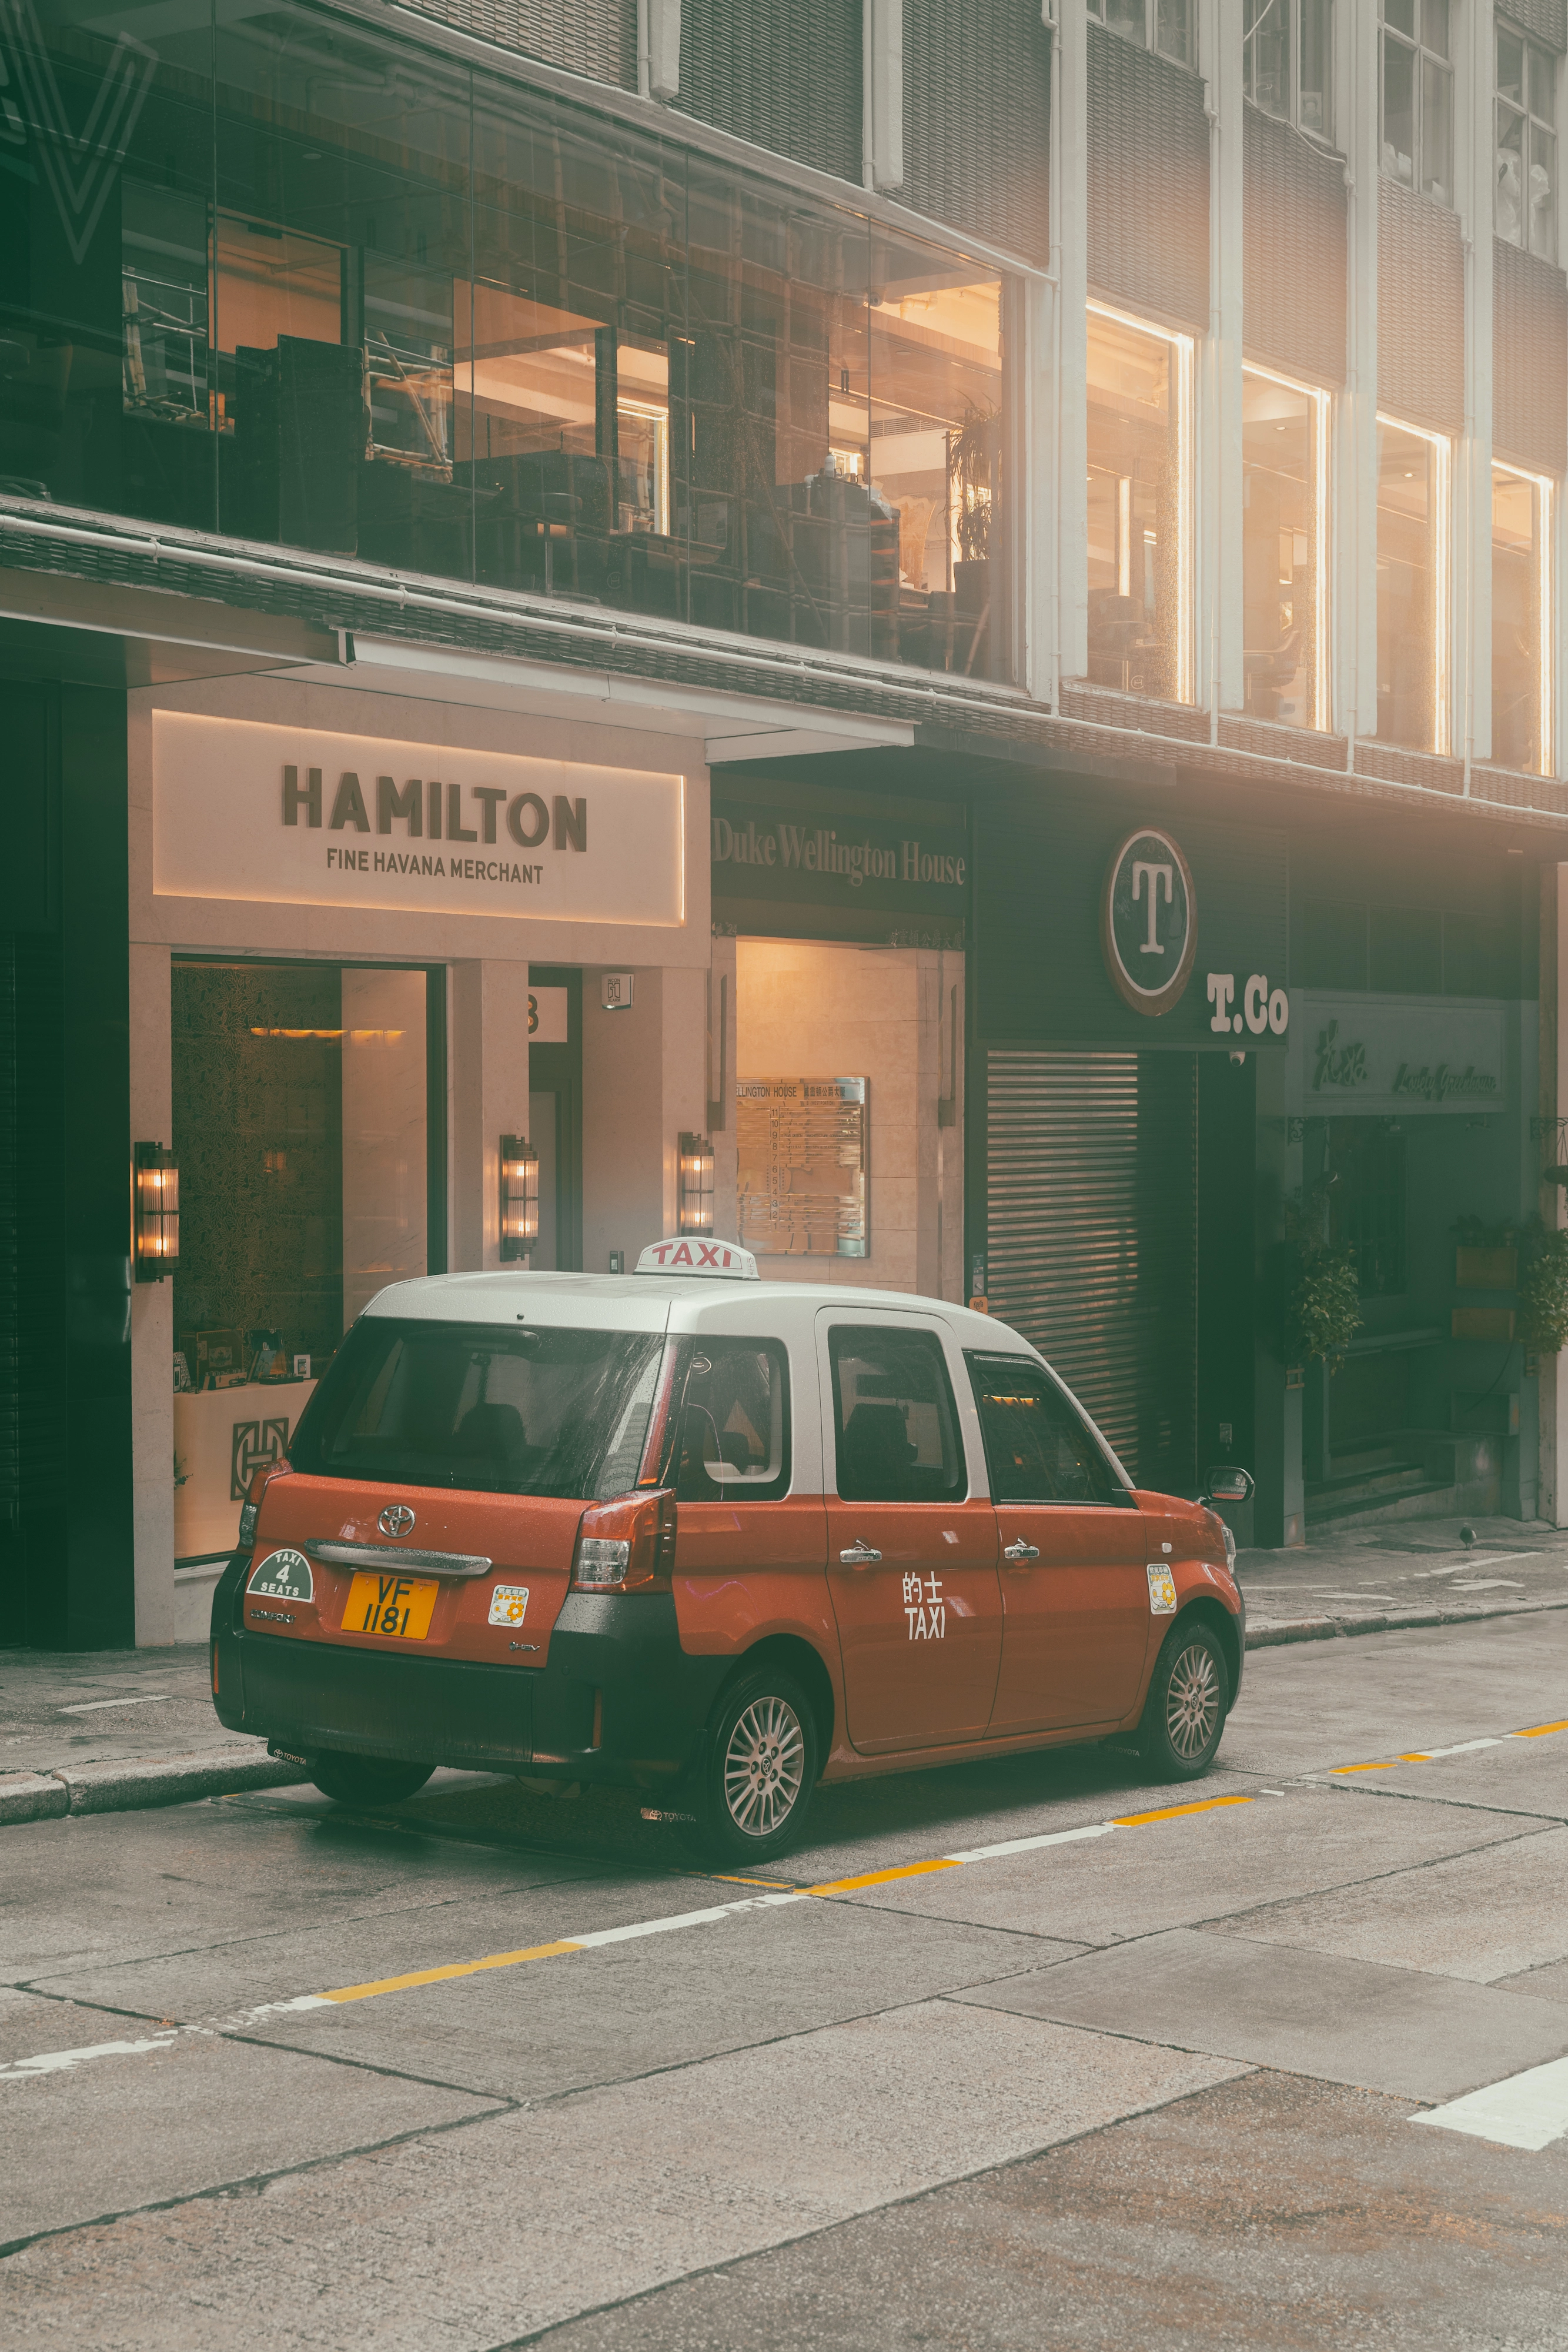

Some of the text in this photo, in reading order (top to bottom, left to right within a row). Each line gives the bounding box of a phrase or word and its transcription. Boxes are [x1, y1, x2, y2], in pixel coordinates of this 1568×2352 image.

[282, 764, 586, 852] HAMILTON
[327, 848, 543, 884] FINE HAVANA MERCHANT
[711, 818, 965, 887] Duke Wellington House
[1132, 861, 1172, 954] T
[1207, 973, 1289, 1035] T.Co
[773, 1086, 797, 1097] HOUSE
[1393, 1064, 1497, 1101] Lovely Greenhouse
[652, 1242, 731, 1267] TAXI
[747, 1257, 754, 1272] 的士
[275, 1552, 302, 1566] TAXI
[276, 1565, 290, 1583] 4
[902, 1571, 942, 1603] 的士
[260, 1582, 299, 1596] SEATS
[379, 1576, 414, 1605] VF
[250, 1609, 296, 1623] COMFORT
[362, 1603, 410, 1635] 1181
[904, 1606, 945, 1640] TAXI
[283, 1752, 307, 1765] TOYOTA
[1114, 1746, 1140, 1756] TOYOTA
[663, 1812, 696, 1822] TOYOTA
